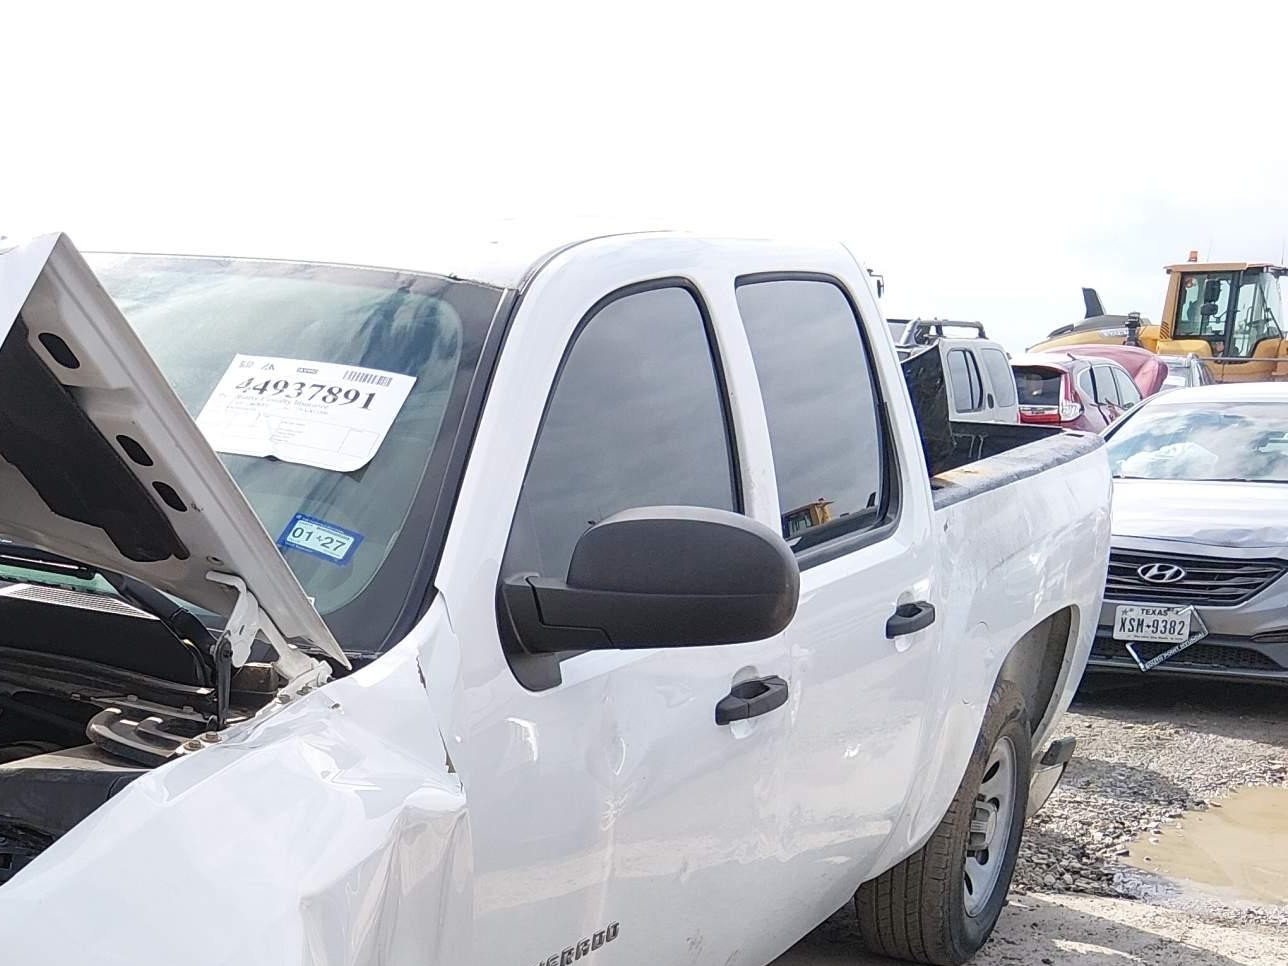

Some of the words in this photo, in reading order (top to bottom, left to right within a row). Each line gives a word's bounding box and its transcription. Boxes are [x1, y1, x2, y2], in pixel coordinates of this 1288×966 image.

[235, 376, 377, 411] 44937891
[292, 527, 313, 541] 01
[320, 536, 346, 551] 27
[1141, 608, 1169, 616] TEXAS
